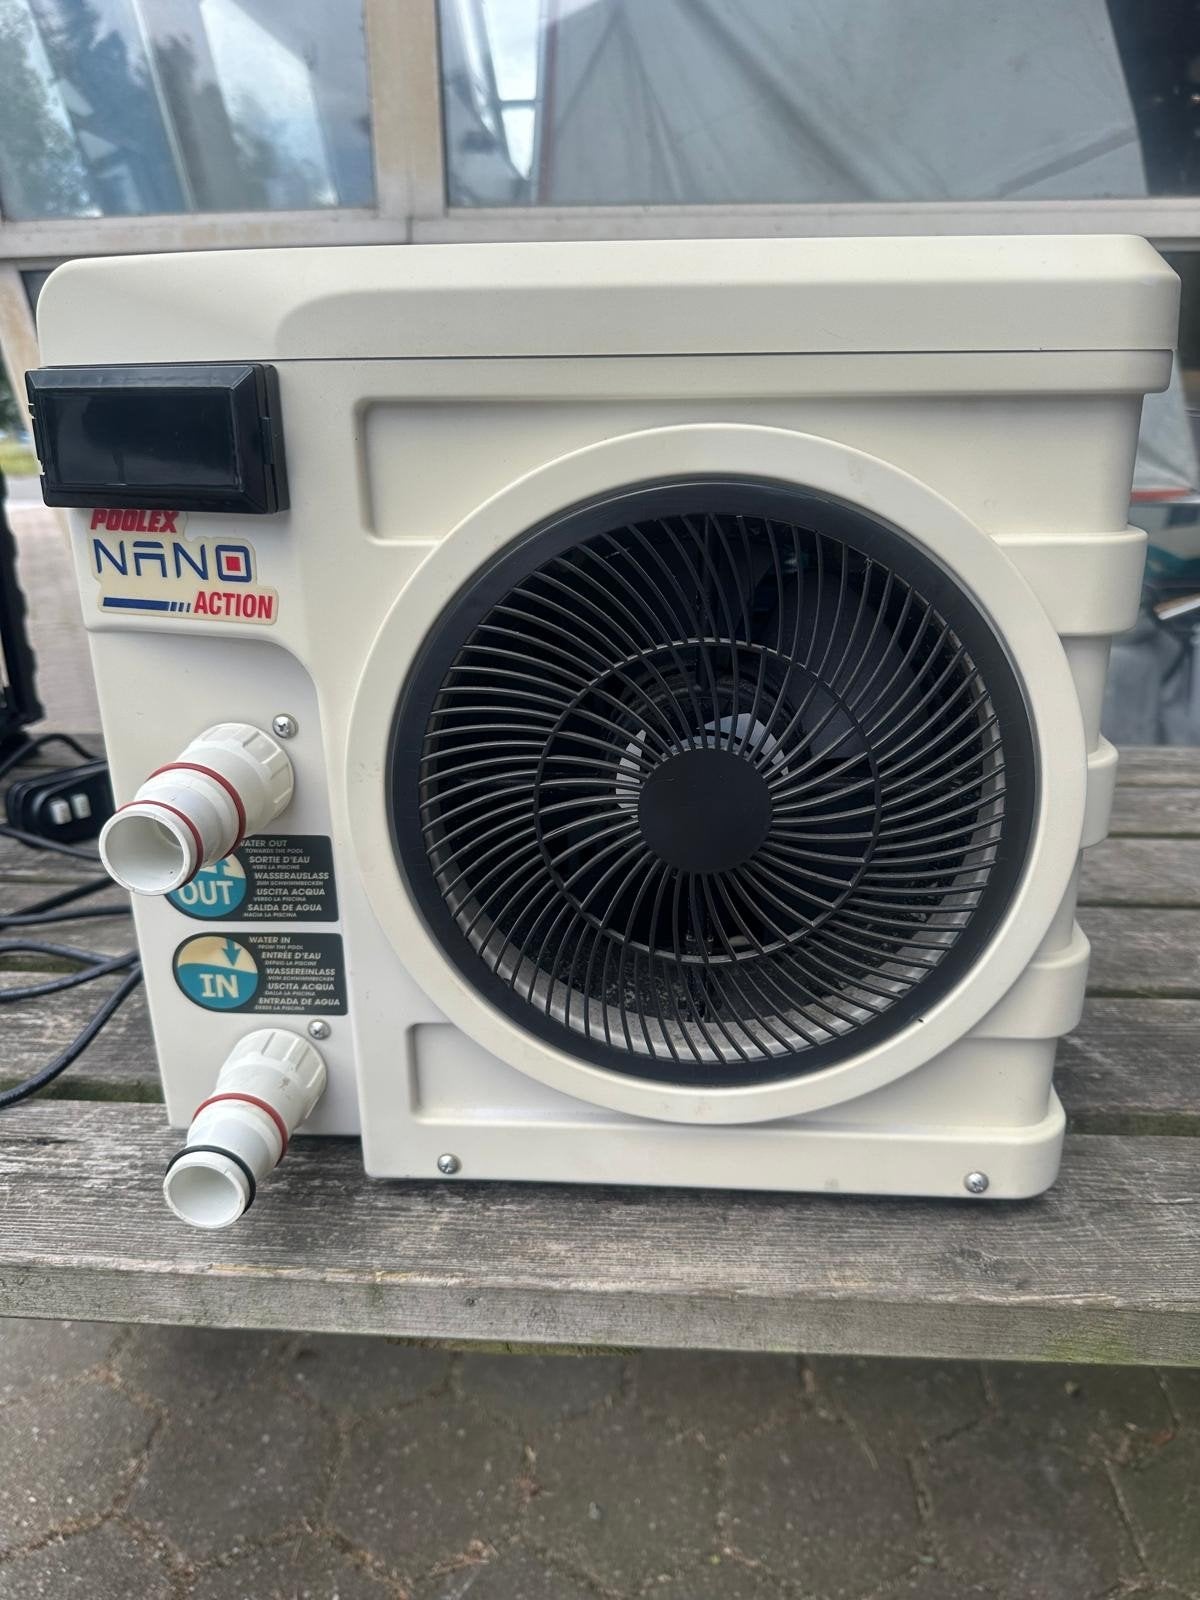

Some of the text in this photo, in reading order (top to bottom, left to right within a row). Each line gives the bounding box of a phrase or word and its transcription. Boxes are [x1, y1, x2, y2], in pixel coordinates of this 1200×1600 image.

[90, 509, 179, 533] POOLEX
[93, 539, 252, 583] NANO
[194, 591, 273, 619] ACTION
[249, 856, 310, 864] SORTIE D'EAU
[254, 872, 329, 880] WASSERAUSLASS
[178, 880, 234, 905] OUT
[256, 888, 326, 896] USCITA ACQUA
[249, 936, 291, 944] WATER IN
[261, 951, 321, 960] ENTRÉE D'EAU
[266, 968, 336, 976] WASSEREINLASS
[200, 974, 239, 998] IN
[268, 983, 335, 991] USCITA ACQUA
[259, 997, 340, 1006] ENTRADA DE AGUA
